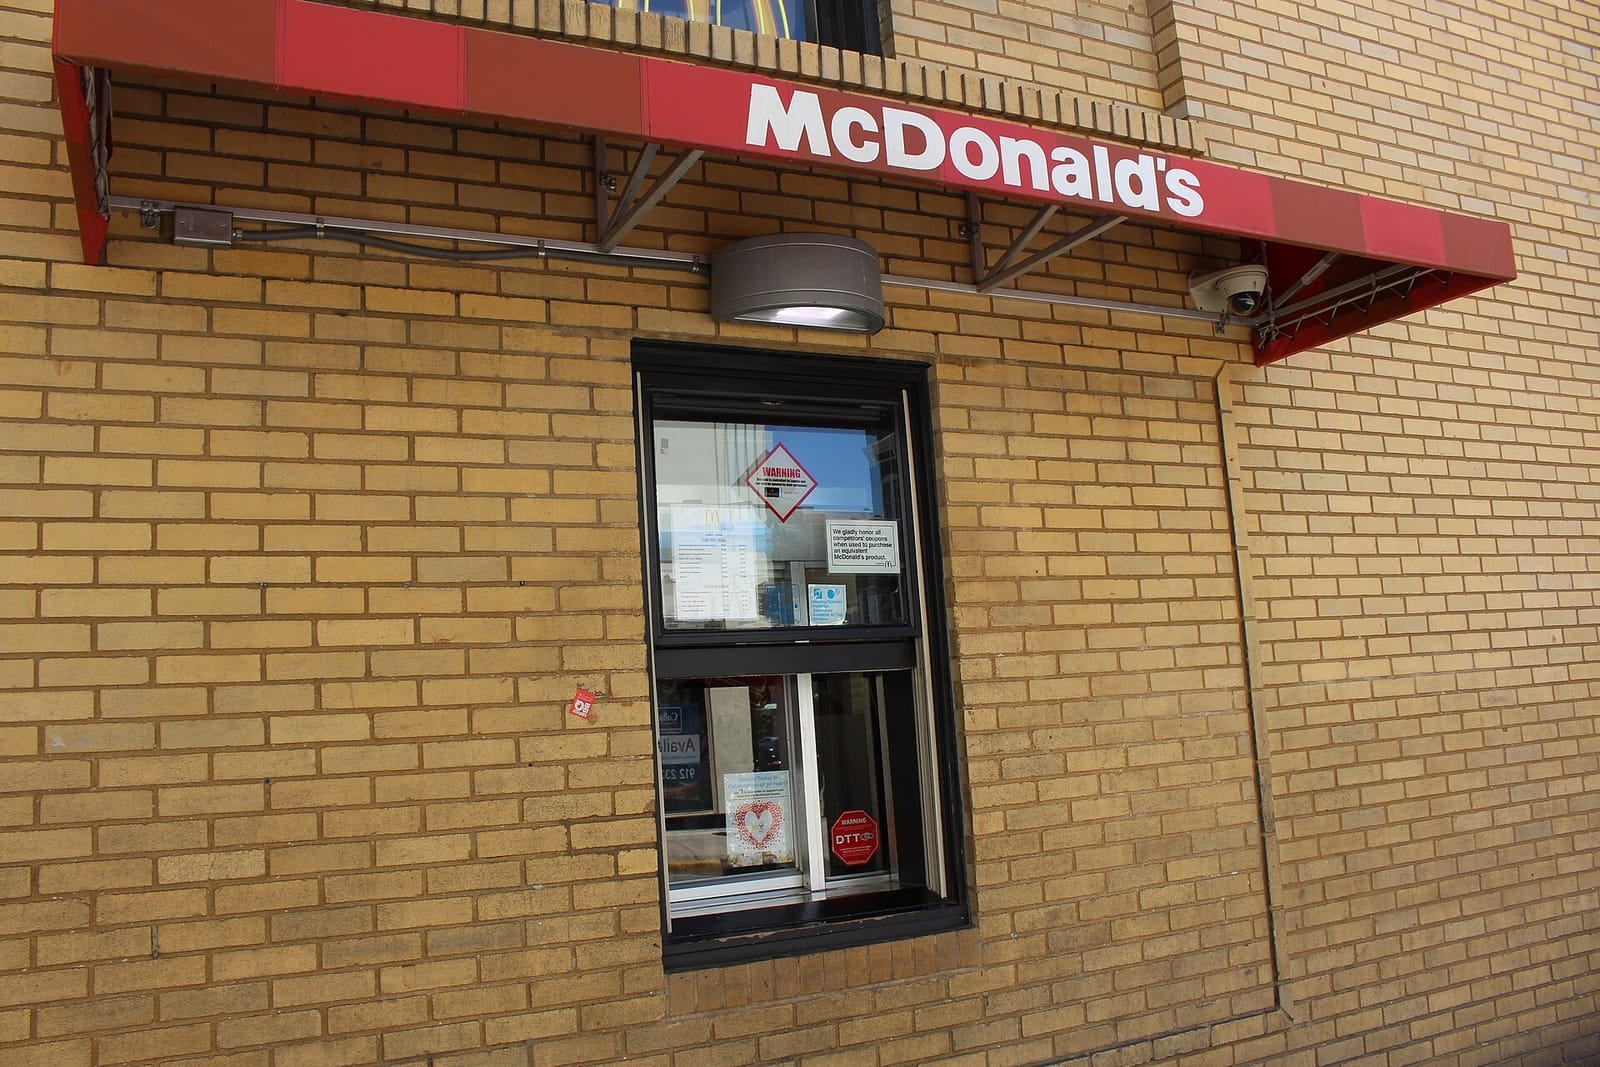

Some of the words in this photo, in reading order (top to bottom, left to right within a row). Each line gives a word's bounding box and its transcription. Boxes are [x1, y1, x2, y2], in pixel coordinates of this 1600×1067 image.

[745, 83, 1205, 217] McDonald's
[762, 467, 800, 478] WARNING
[836, 834, 860, 844] DTT
